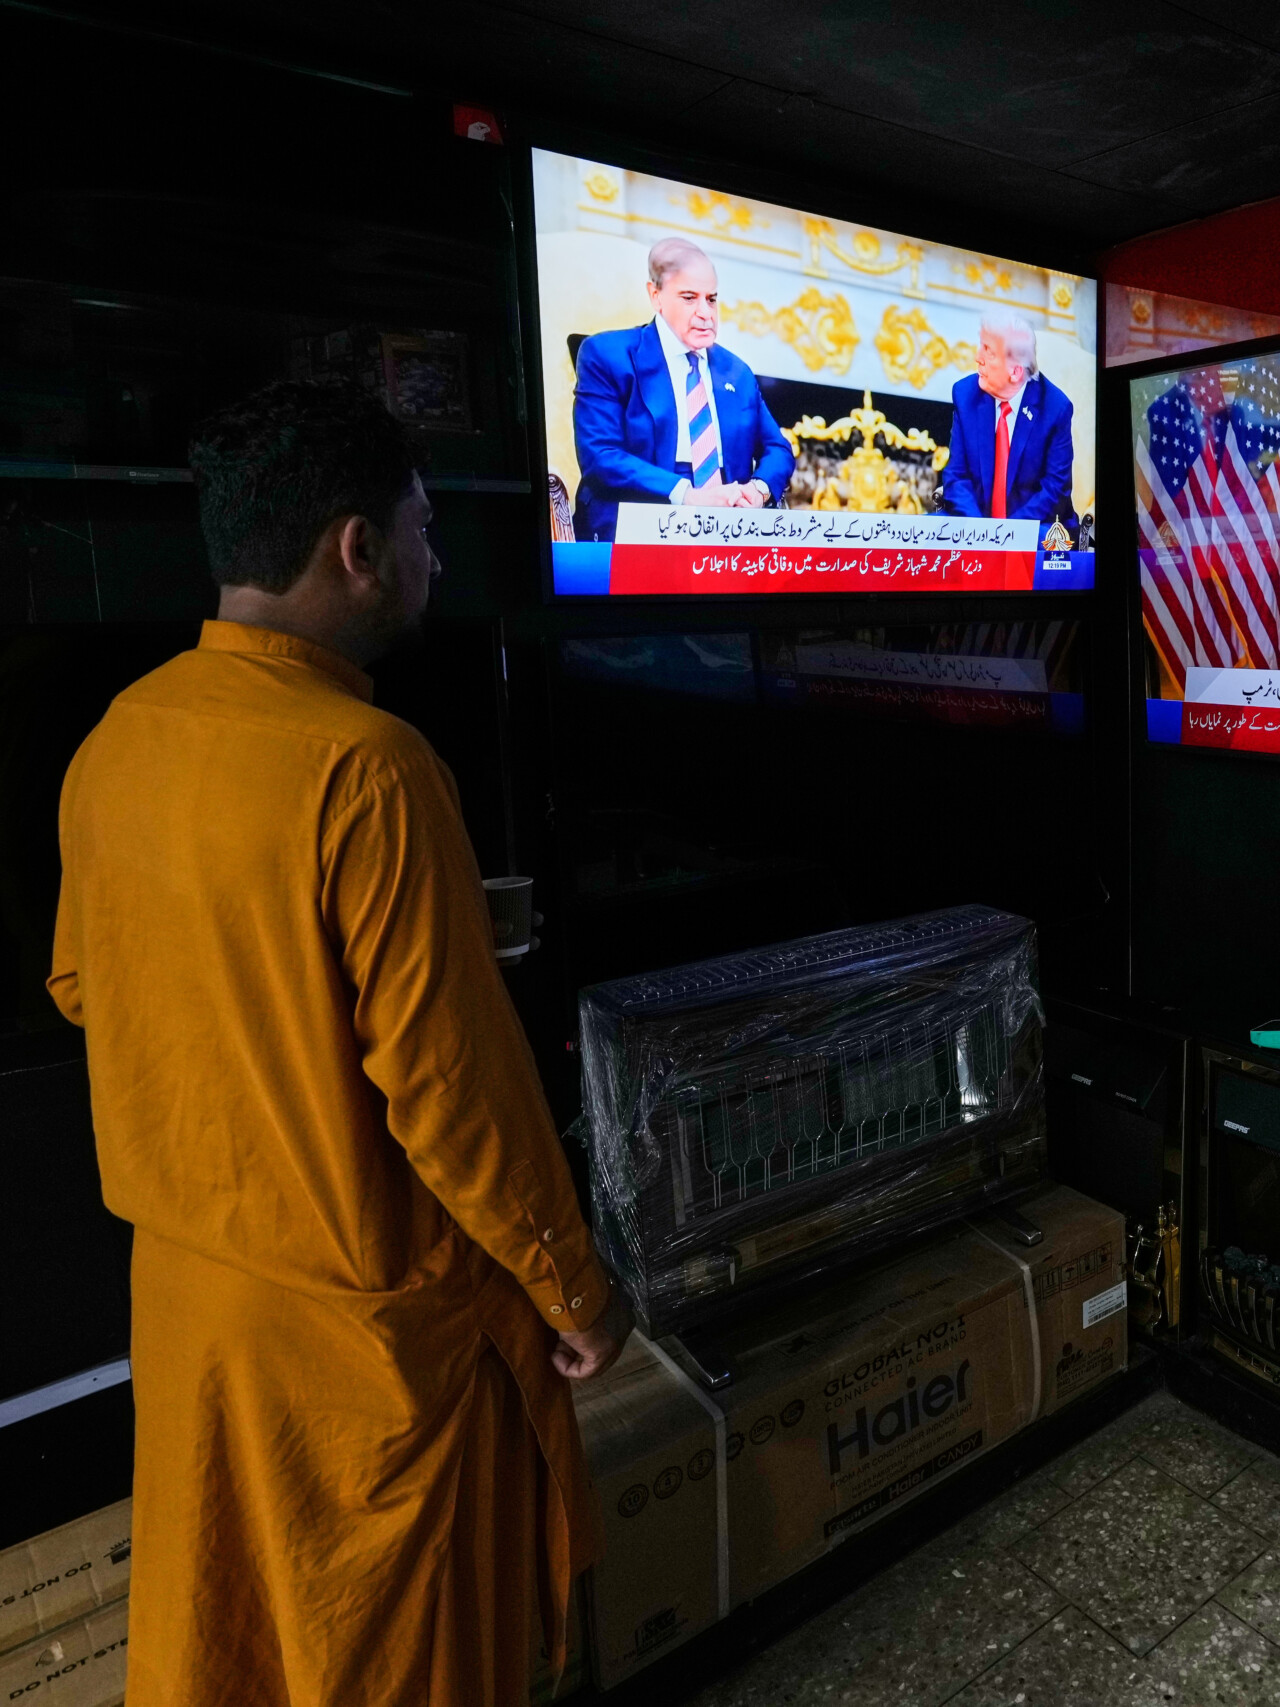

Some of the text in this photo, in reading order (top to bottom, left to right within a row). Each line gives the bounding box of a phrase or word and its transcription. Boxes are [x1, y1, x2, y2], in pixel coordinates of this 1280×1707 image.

[658, 510, 677, 540] گیا
[675, 522, 688, 534] ہو
[690, 514, 719, 538] اتفاق
[719, 523, 730, 543] پر
[731, 517, 760, 539] بندی
[761, 514, 786, 538] جنگ
[788, 515, 822, 541] مشروط
[844, 519, 861, 538] کے
[862, 520, 891, 542] ہفتوں
[891, 530, 901, 540] دو
[936, 522, 951, 541] کے
[976, 529, 988, 542] اور
[989, 523, 1014, 546] امریکہ
[952, 528, 976, 545] ایران
[693, 555, 728, 575] اجلاس
[731, 552, 742, 573] کا
[741, 552, 769, 576] کابینہ
[768, 547, 793, 575] وفاقی
[795, 553, 812, 575] میں
[815, 557, 858, 573] صدارت
[859, 549, 873, 575] کی
[873, 552, 904, 577] شریف
[905, 554, 928, 576] شہباز
[928, 555, 942, 572] محمد
[1189, 711, 1199, 728] رہا
[1199, 712, 1222, 730] نمایاں
[1223, 719, 1231, 734] پر
[1232, 713, 1247, 728] طور
[1249, 713, 1263, 730] کے
[824, 1342, 912, 1398] GLOBAL
[825, 1330, 967, 1412] CONNECTED AC BRAND
[827, 1359, 970, 1476] Haier
[936, 1435, 978, 1470] CANDY
[65, 1562, 92, 1578] DO
[20, 1576, 60, 1599] NOT
[10, 1638, 128, 1700] DO NOT STE
